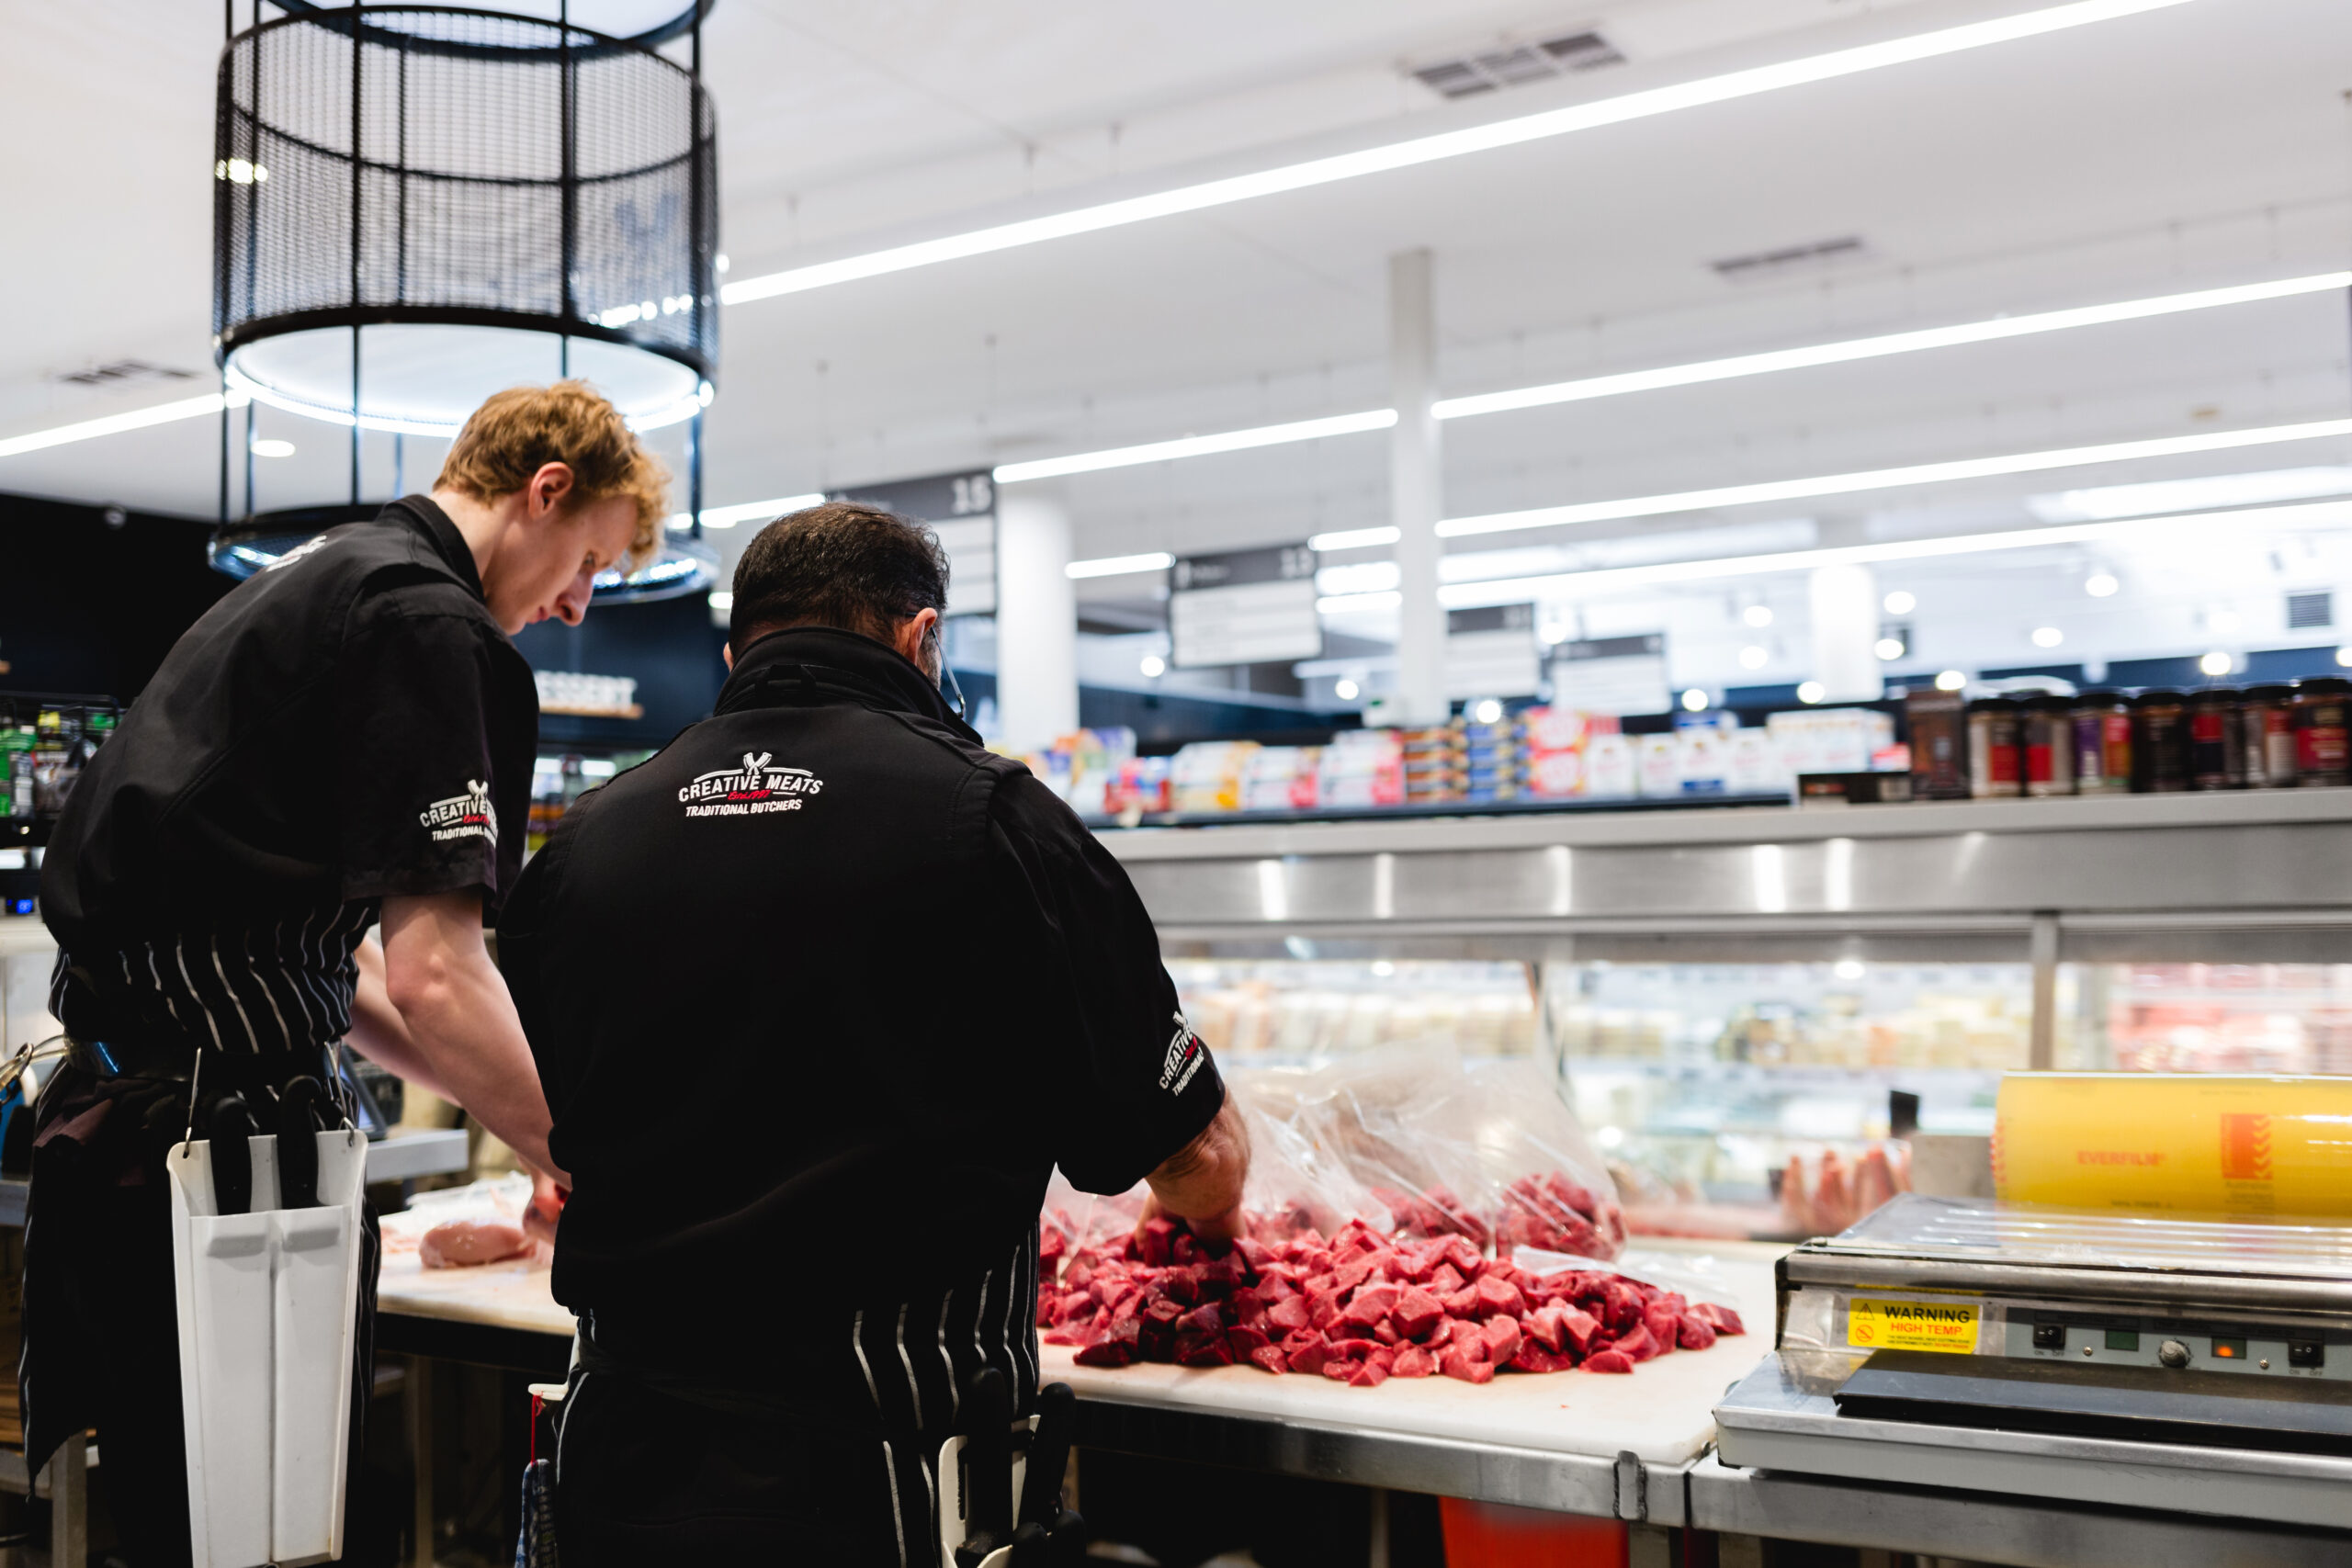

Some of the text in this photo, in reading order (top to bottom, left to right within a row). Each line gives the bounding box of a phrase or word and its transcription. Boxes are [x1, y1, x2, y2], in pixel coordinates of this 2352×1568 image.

[678, 774, 823, 802] CREATIVE MEATS
[419, 799, 487, 828] CREATIVE
[685, 798, 803, 817] TRADITIONAL BUTCHERS
[432, 825, 484, 841] TRADITIONAL
[1884, 1305, 1971, 1324] WARNING
[1891, 1322, 1964, 1337] HIGH TEMP.
